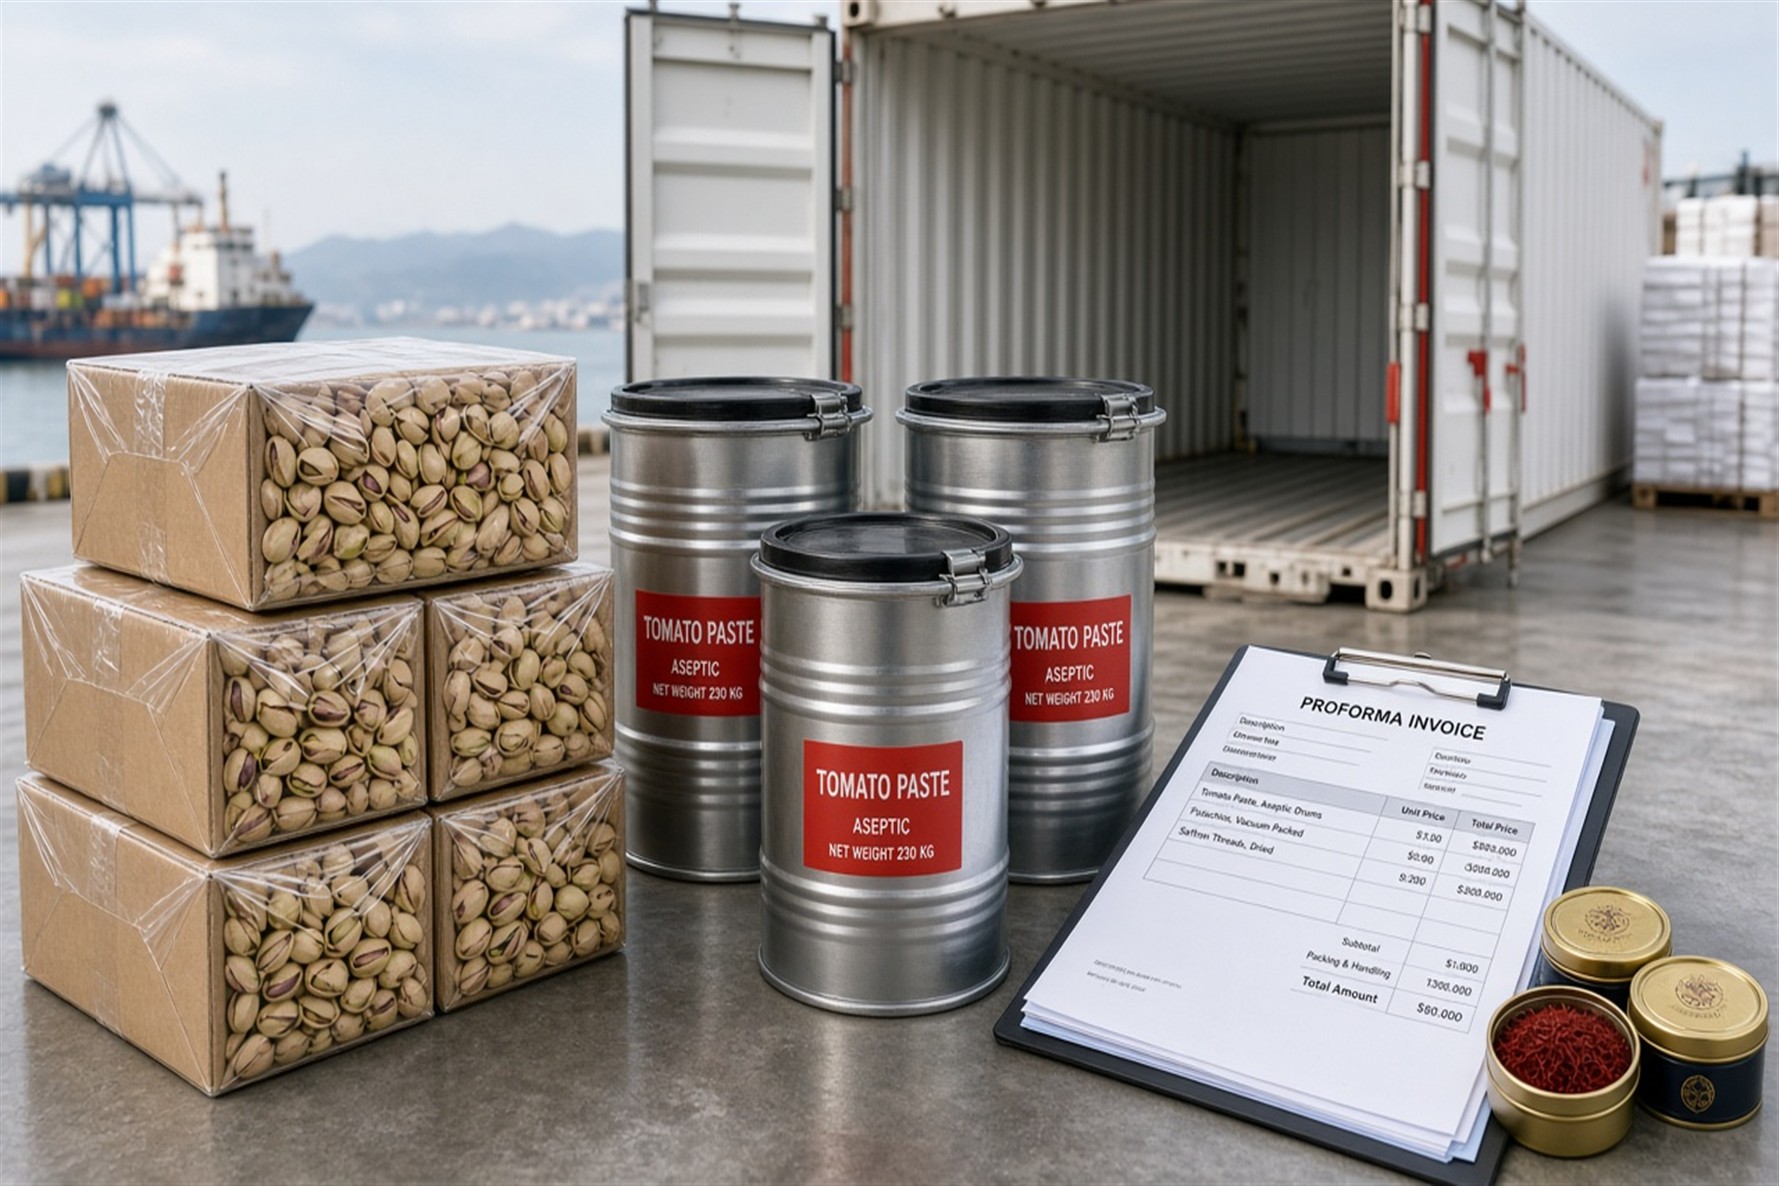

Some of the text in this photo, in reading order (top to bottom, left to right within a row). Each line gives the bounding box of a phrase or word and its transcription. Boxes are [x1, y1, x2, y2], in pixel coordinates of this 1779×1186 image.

[643, 615, 755, 645] TOMATO PASTE
[1014, 620, 1124, 650] TOMATO PASTE
[671, 658, 720, 677] ASEPTIC
[1045, 664, 1095, 683] ASEPTIC
[653, 683, 743, 700] NET WEIGHT 230 KG
[1025, 691, 1043, 705] NET
[1045, 690, 1082, 705] WEIGHT
[1102, 687, 1114, 701] KG
[1300, 696, 1487, 741] PROFORMA INVOICE
[816, 768, 951, 800] TOMATO PASTE
[1401, 805, 1446, 822] Unit Price
[852, 817, 910, 836] ASEPTIC
[1472, 818, 1519, 836] Total Price
[829, 844, 935, 861] NET WEIGHT 230 KG
[1341, 936, 1381, 953] Subtotal
[1305, 950, 1341, 968] Packing
[1302, 975, 1379, 1004] Total Amount
